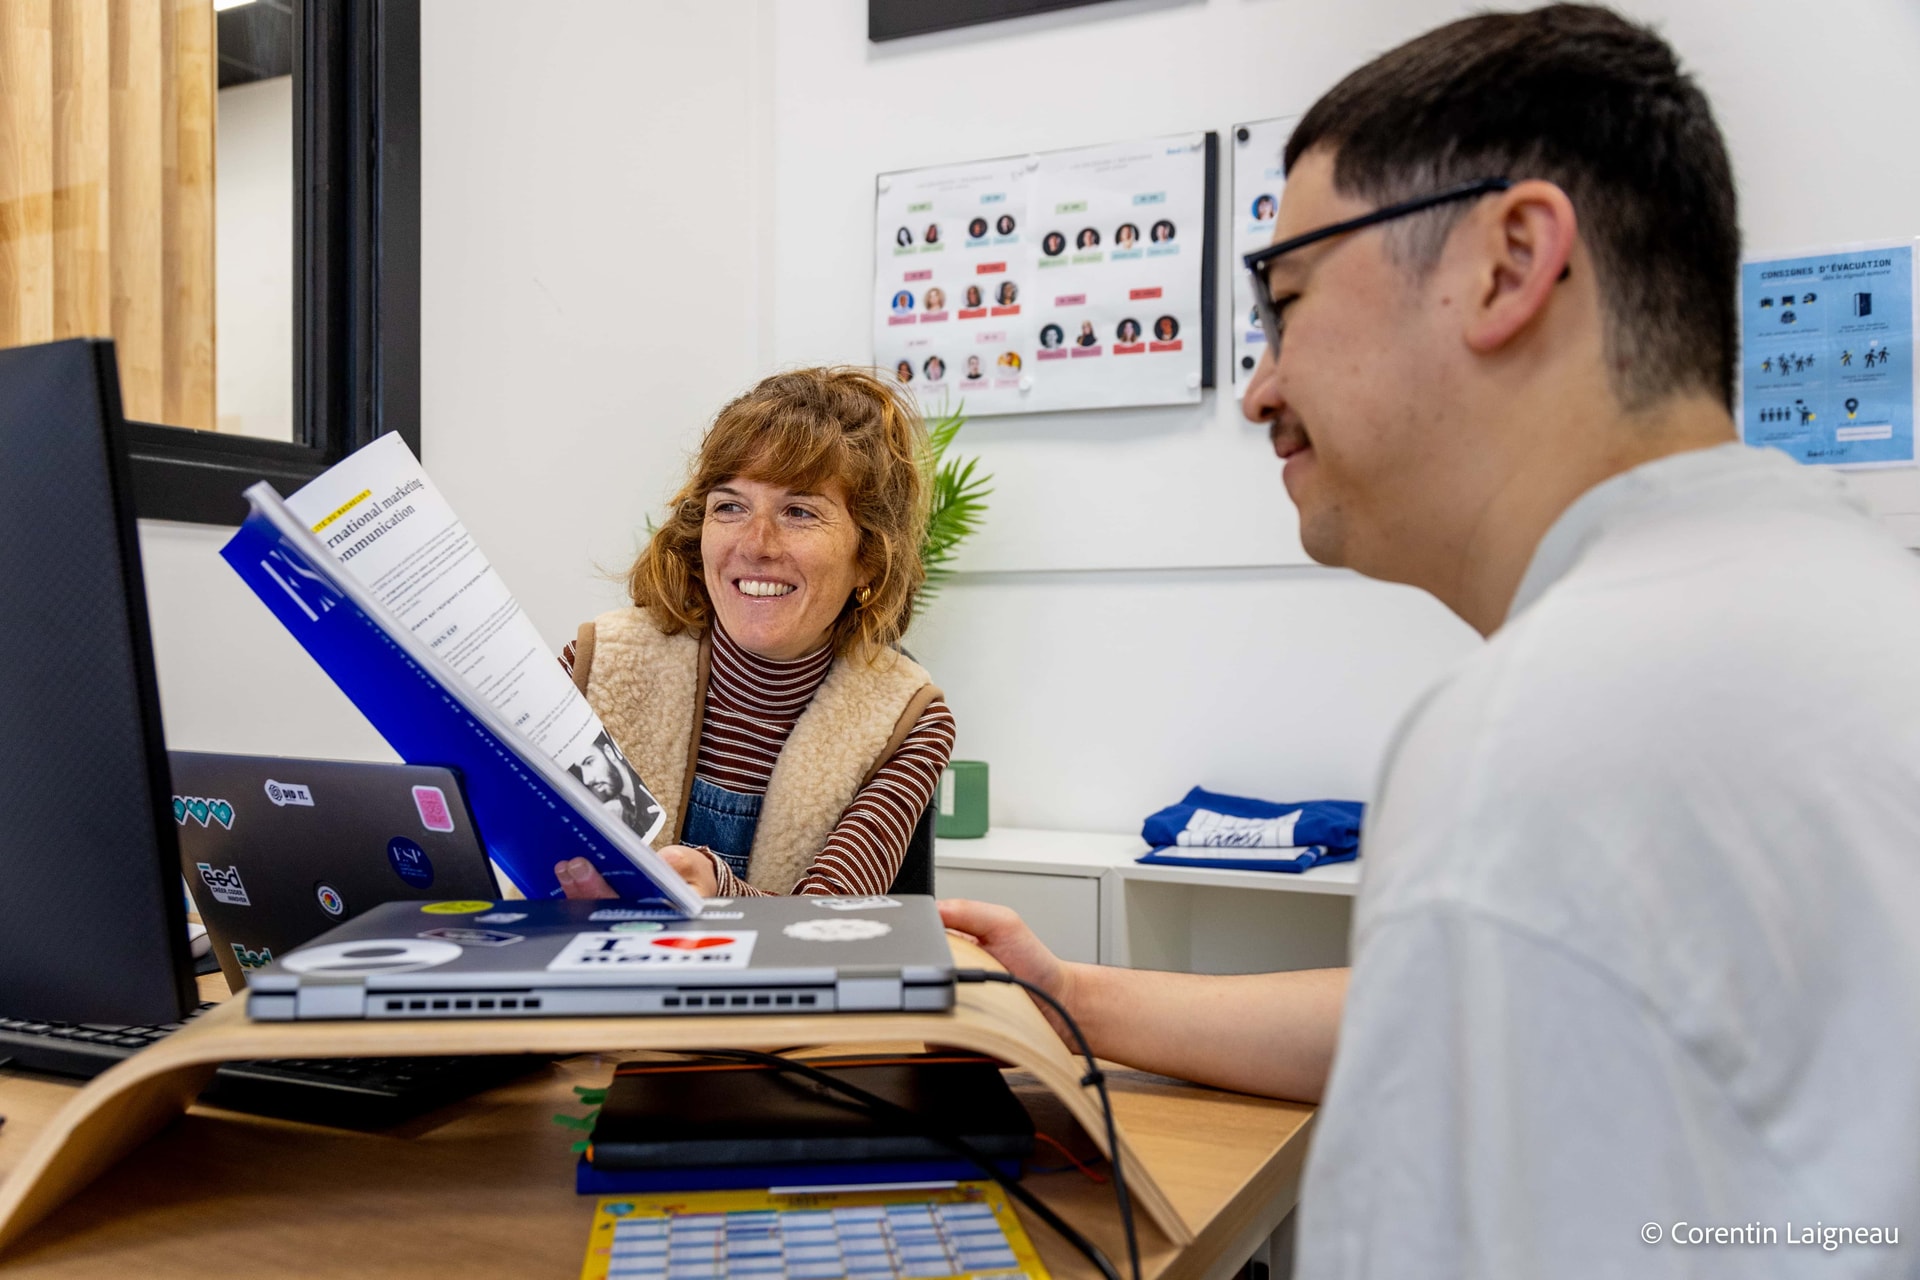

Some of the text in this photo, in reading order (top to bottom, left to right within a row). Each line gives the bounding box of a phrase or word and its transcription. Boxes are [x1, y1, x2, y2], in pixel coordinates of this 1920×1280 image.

[1761, 259, 1891, 280] CONSIGNES D'ÉVACUATION
[327, 478, 424, 549] rnational marketing
[282, 789, 308, 800] DID IT.
[393, 847, 421, 863] ESP
[586, 937, 633, 953] I
